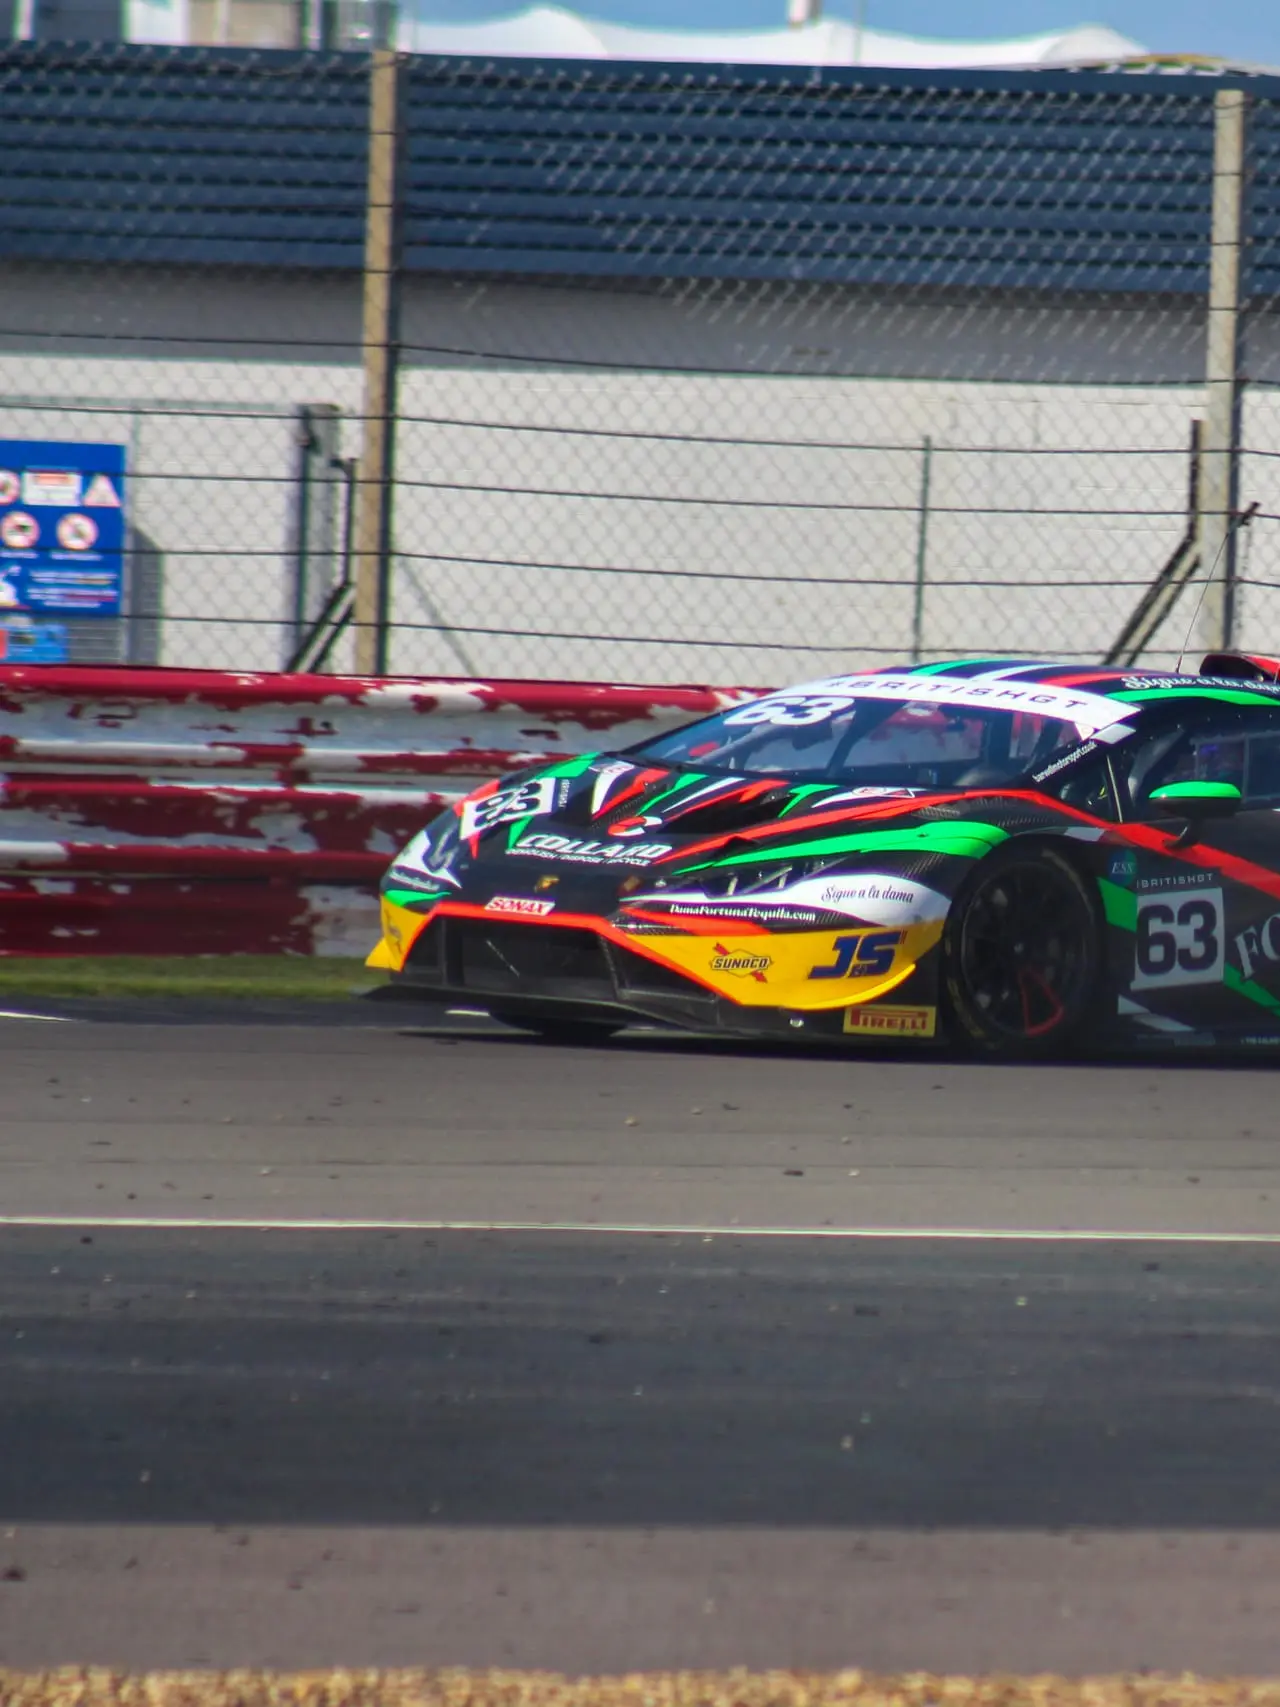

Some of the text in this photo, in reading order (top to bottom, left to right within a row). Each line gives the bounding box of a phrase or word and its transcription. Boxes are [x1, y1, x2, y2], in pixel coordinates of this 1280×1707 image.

[852, 680, 1088, 709] BRITISHGT
[724, 696, 855, 726] 63
[516, 834, 673, 859] COLLARD
[1141, 873, 1214, 888] BRITISHGT
[488, 899, 547, 914] SONAX
[821, 885, 915, 903] Sigue a la dama
[670, 903, 817, 922] DamaFortunaTequila.com
[1137, 900, 1219, 977] 63
[713, 956, 769, 970] SUNOCO
[808, 930, 903, 979] JS
[850, 1007, 929, 1032] PIRELLI
